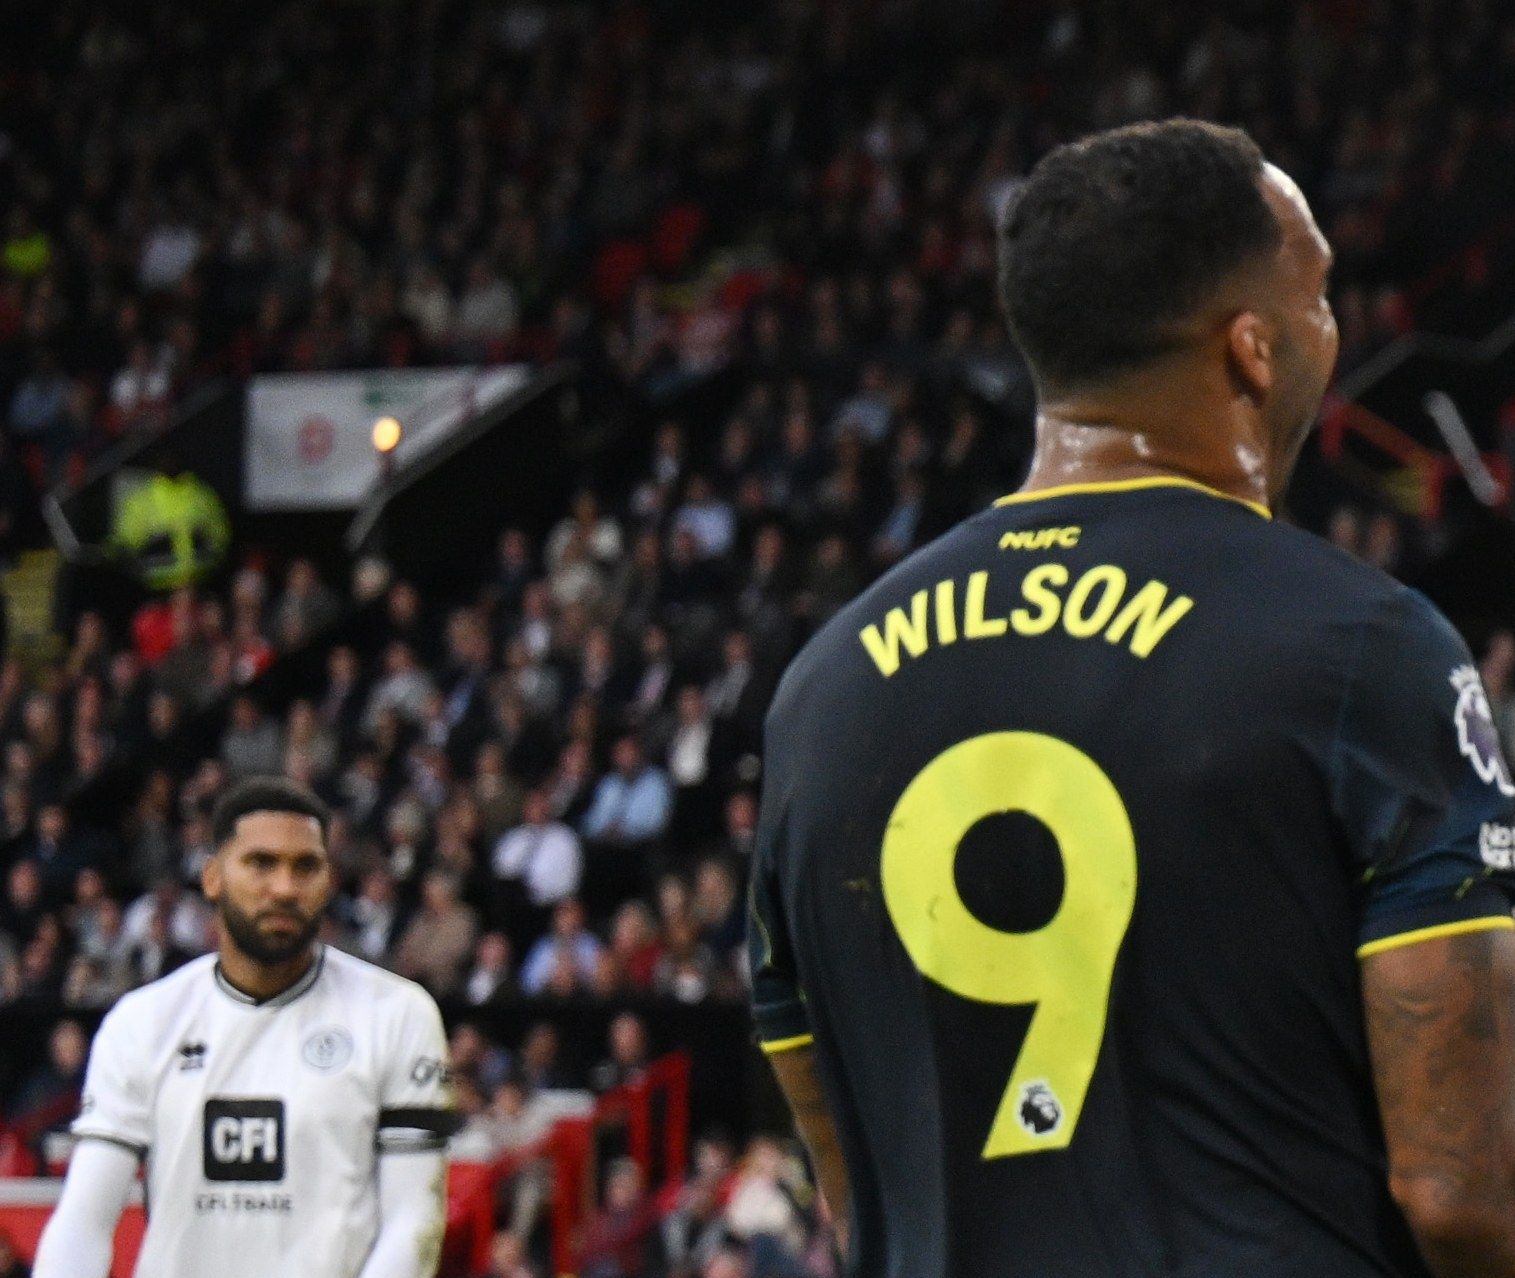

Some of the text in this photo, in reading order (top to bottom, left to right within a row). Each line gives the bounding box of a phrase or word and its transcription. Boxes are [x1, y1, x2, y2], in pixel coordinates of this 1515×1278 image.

[998, 526, 1082, 550] NUFC
[859, 563, 1194, 677] WILSON
[880, 731, 1138, 1160] 9
[211, 1116, 278, 1164] CFI
